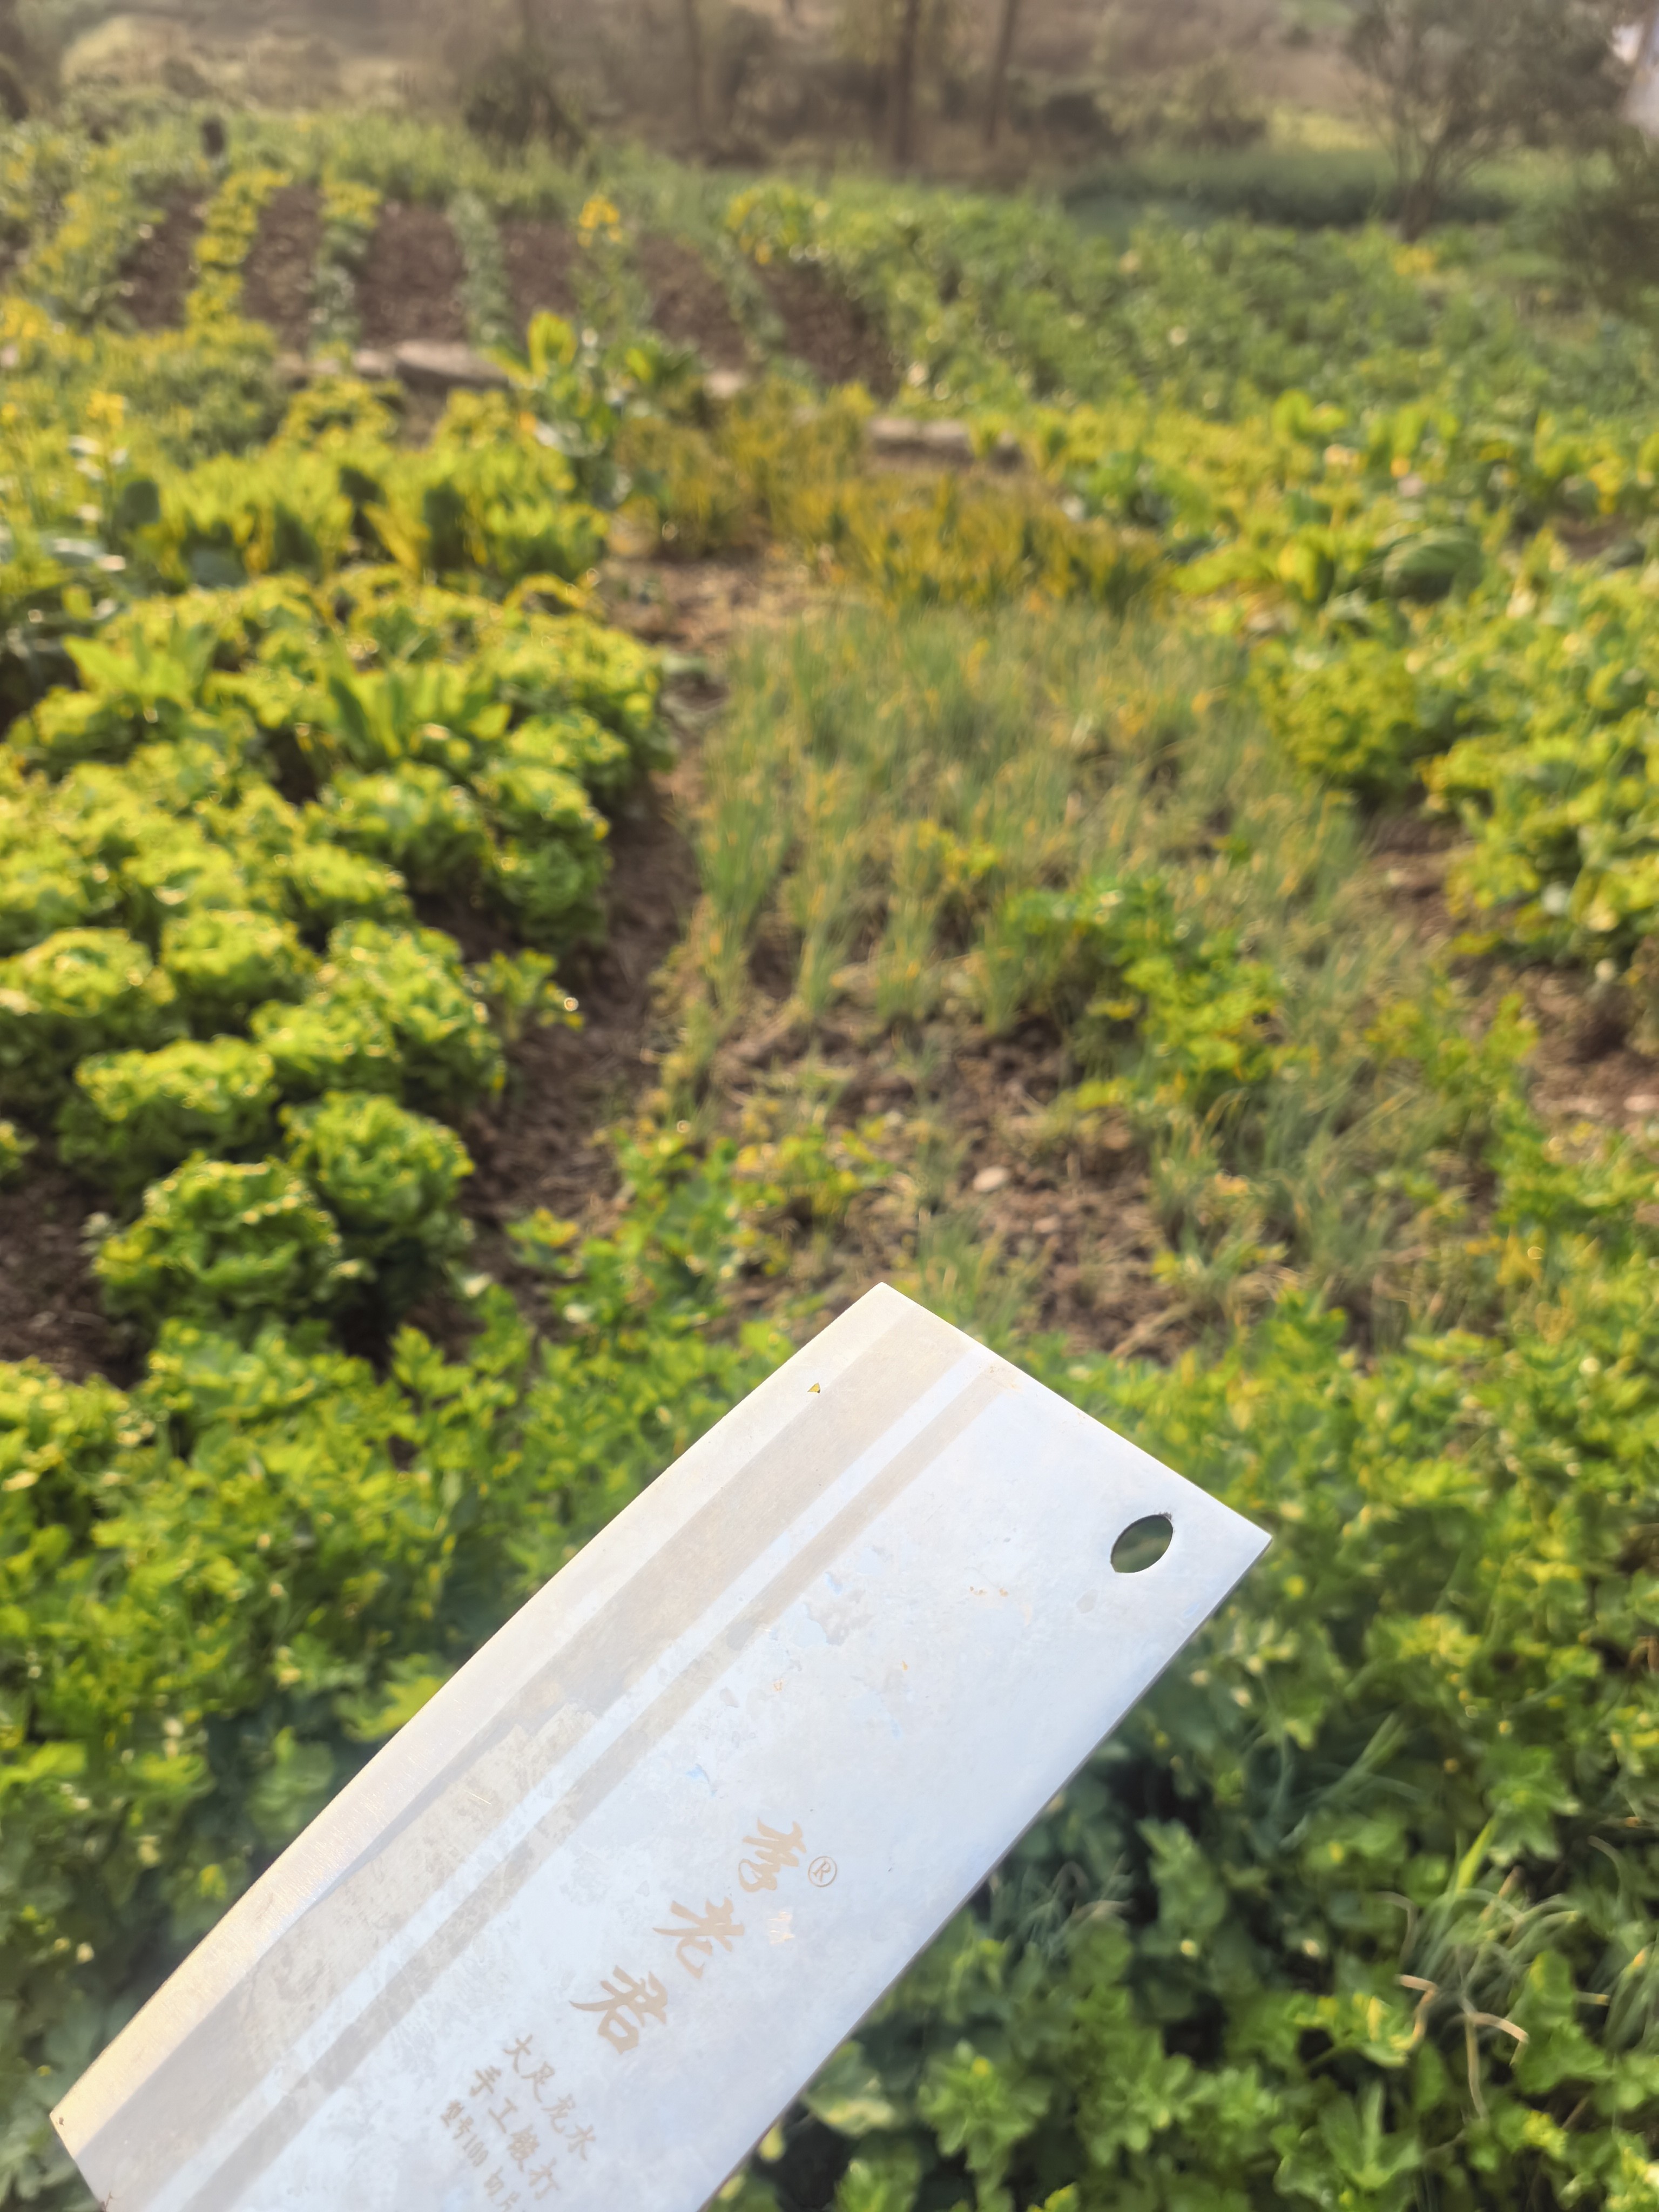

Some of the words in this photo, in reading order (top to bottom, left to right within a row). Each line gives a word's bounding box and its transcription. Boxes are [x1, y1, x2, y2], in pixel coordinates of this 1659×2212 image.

[569, 1817, 806, 2054] 李老君
[469, 2065, 561, 2200] 手工锻打
[503, 2033, 596, 2161] 大足龙水
